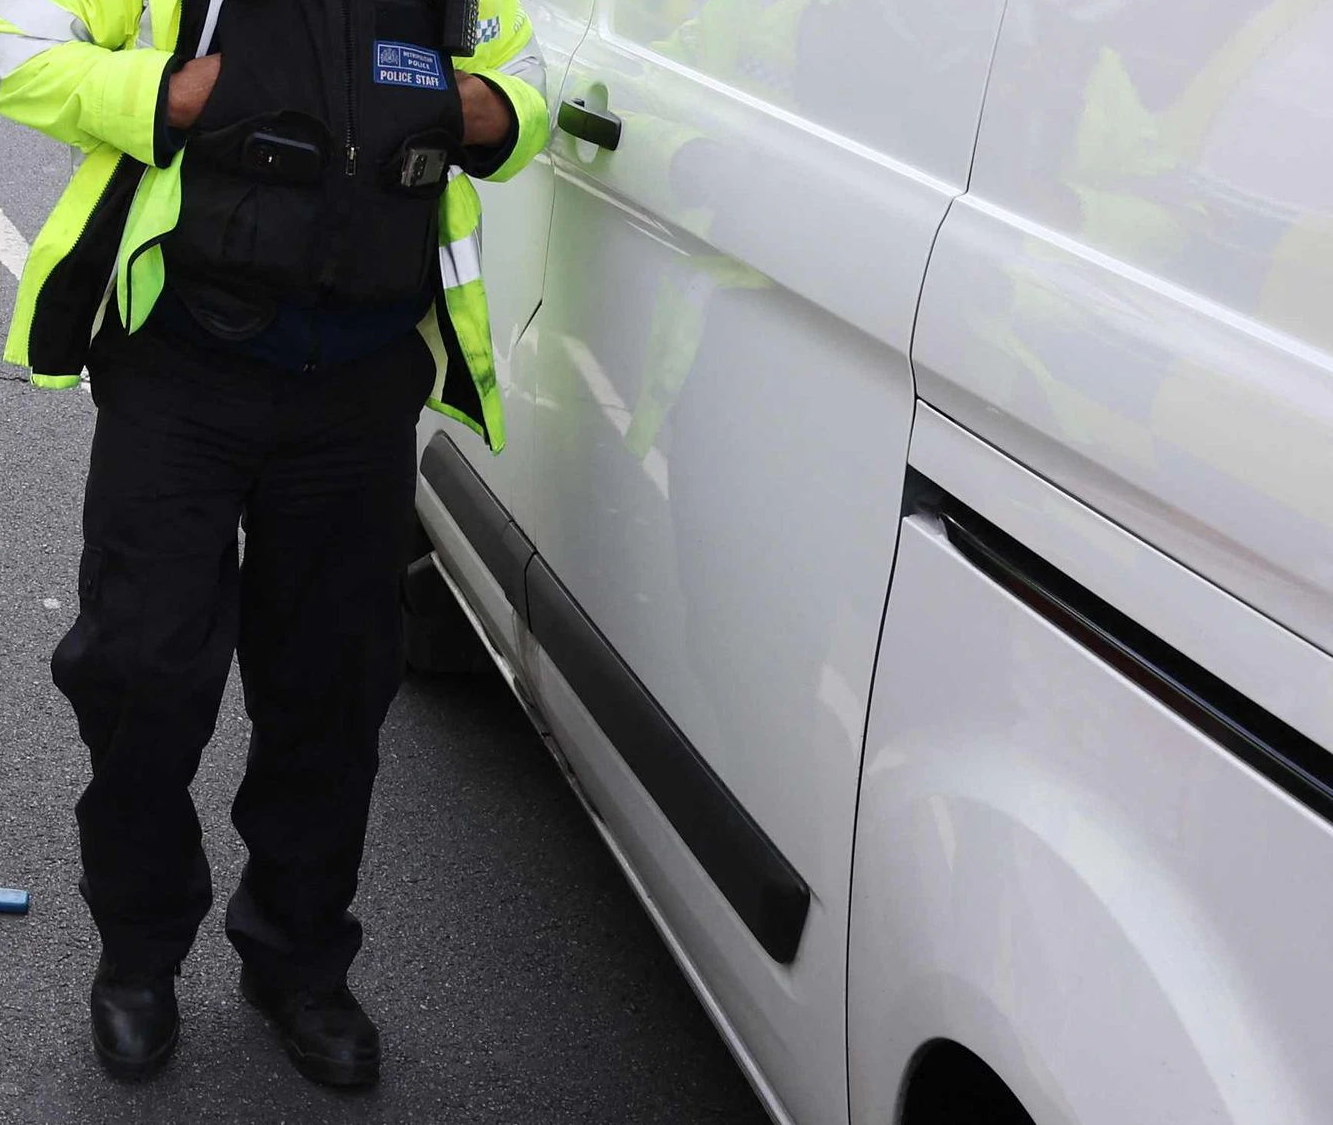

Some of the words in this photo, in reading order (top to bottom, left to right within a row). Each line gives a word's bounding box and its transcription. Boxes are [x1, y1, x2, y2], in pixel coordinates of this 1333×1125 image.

[408, 59, 430, 70] POLICE
[380, 70, 412, 83] POLICE
[416, 74, 440, 87] STAFF
